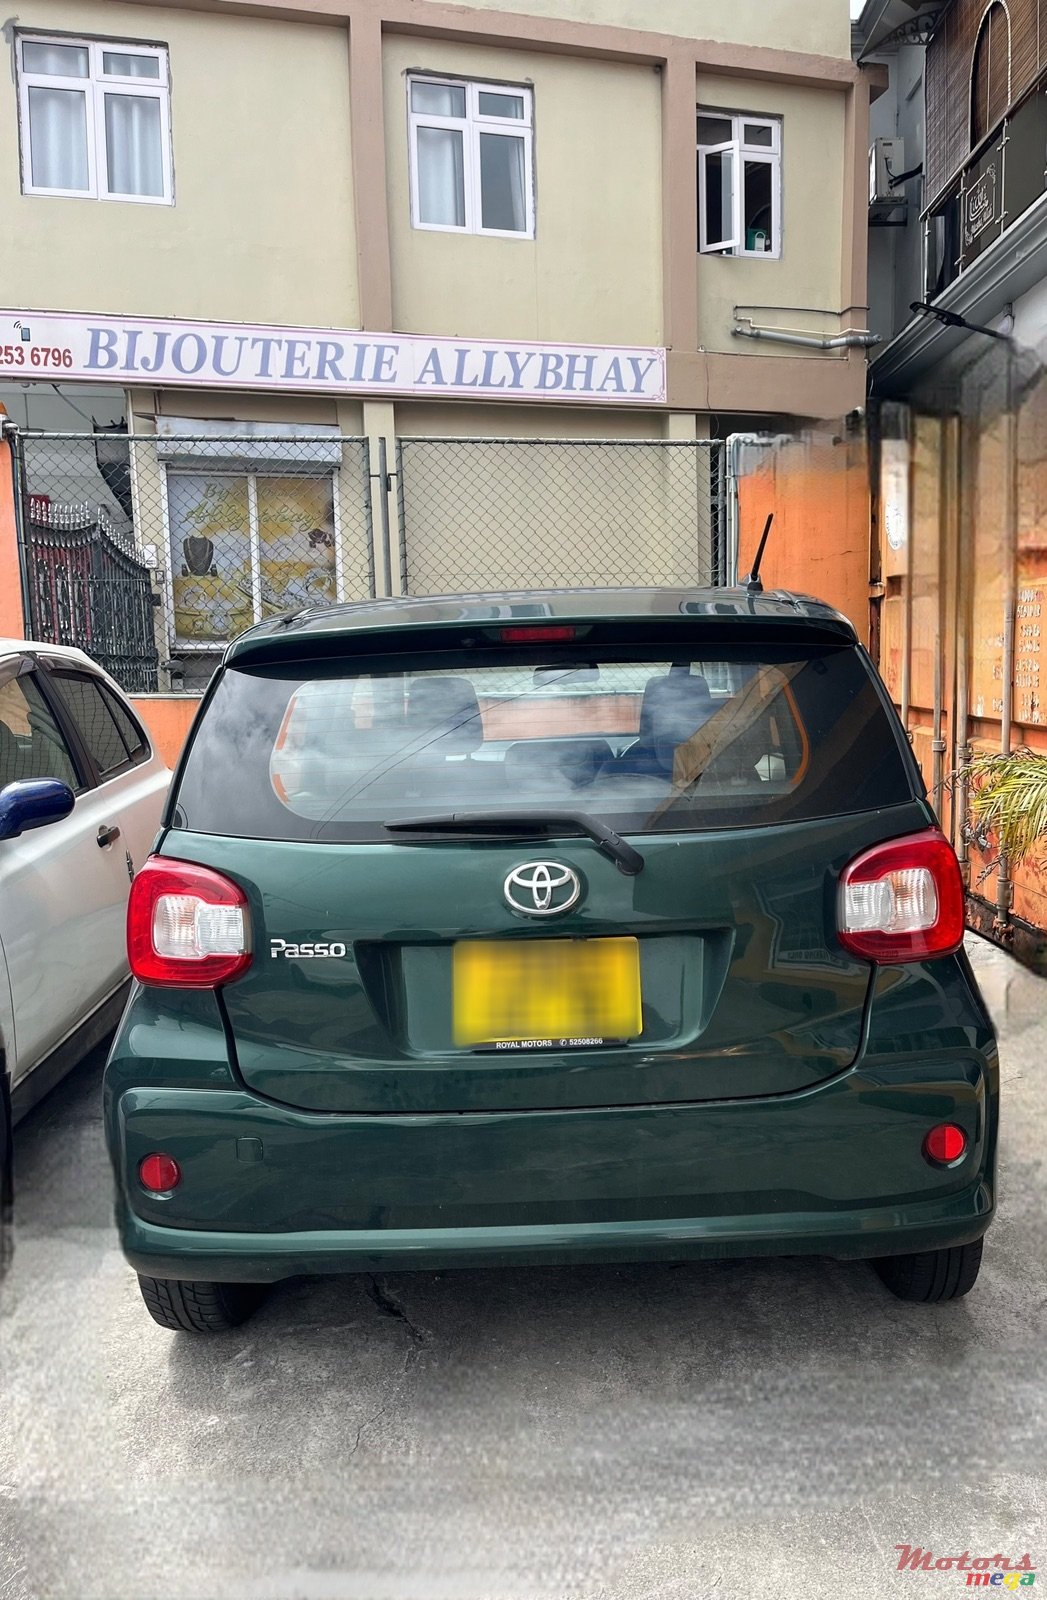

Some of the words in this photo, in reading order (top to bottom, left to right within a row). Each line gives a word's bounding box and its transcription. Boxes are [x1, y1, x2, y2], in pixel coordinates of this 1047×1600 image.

[30, 346, 73, 368] 6796
[83, 327, 400, 384] BIJOUTERIE
[413, 346, 657, 393] ALLYBHAY
[270, 938, 346, 958] Passo
[496, 1040, 520, 1049] ROYAL
[521, 1039, 552, 1048] MOTORS
[569, 1037, 603, 1046] 52508266
